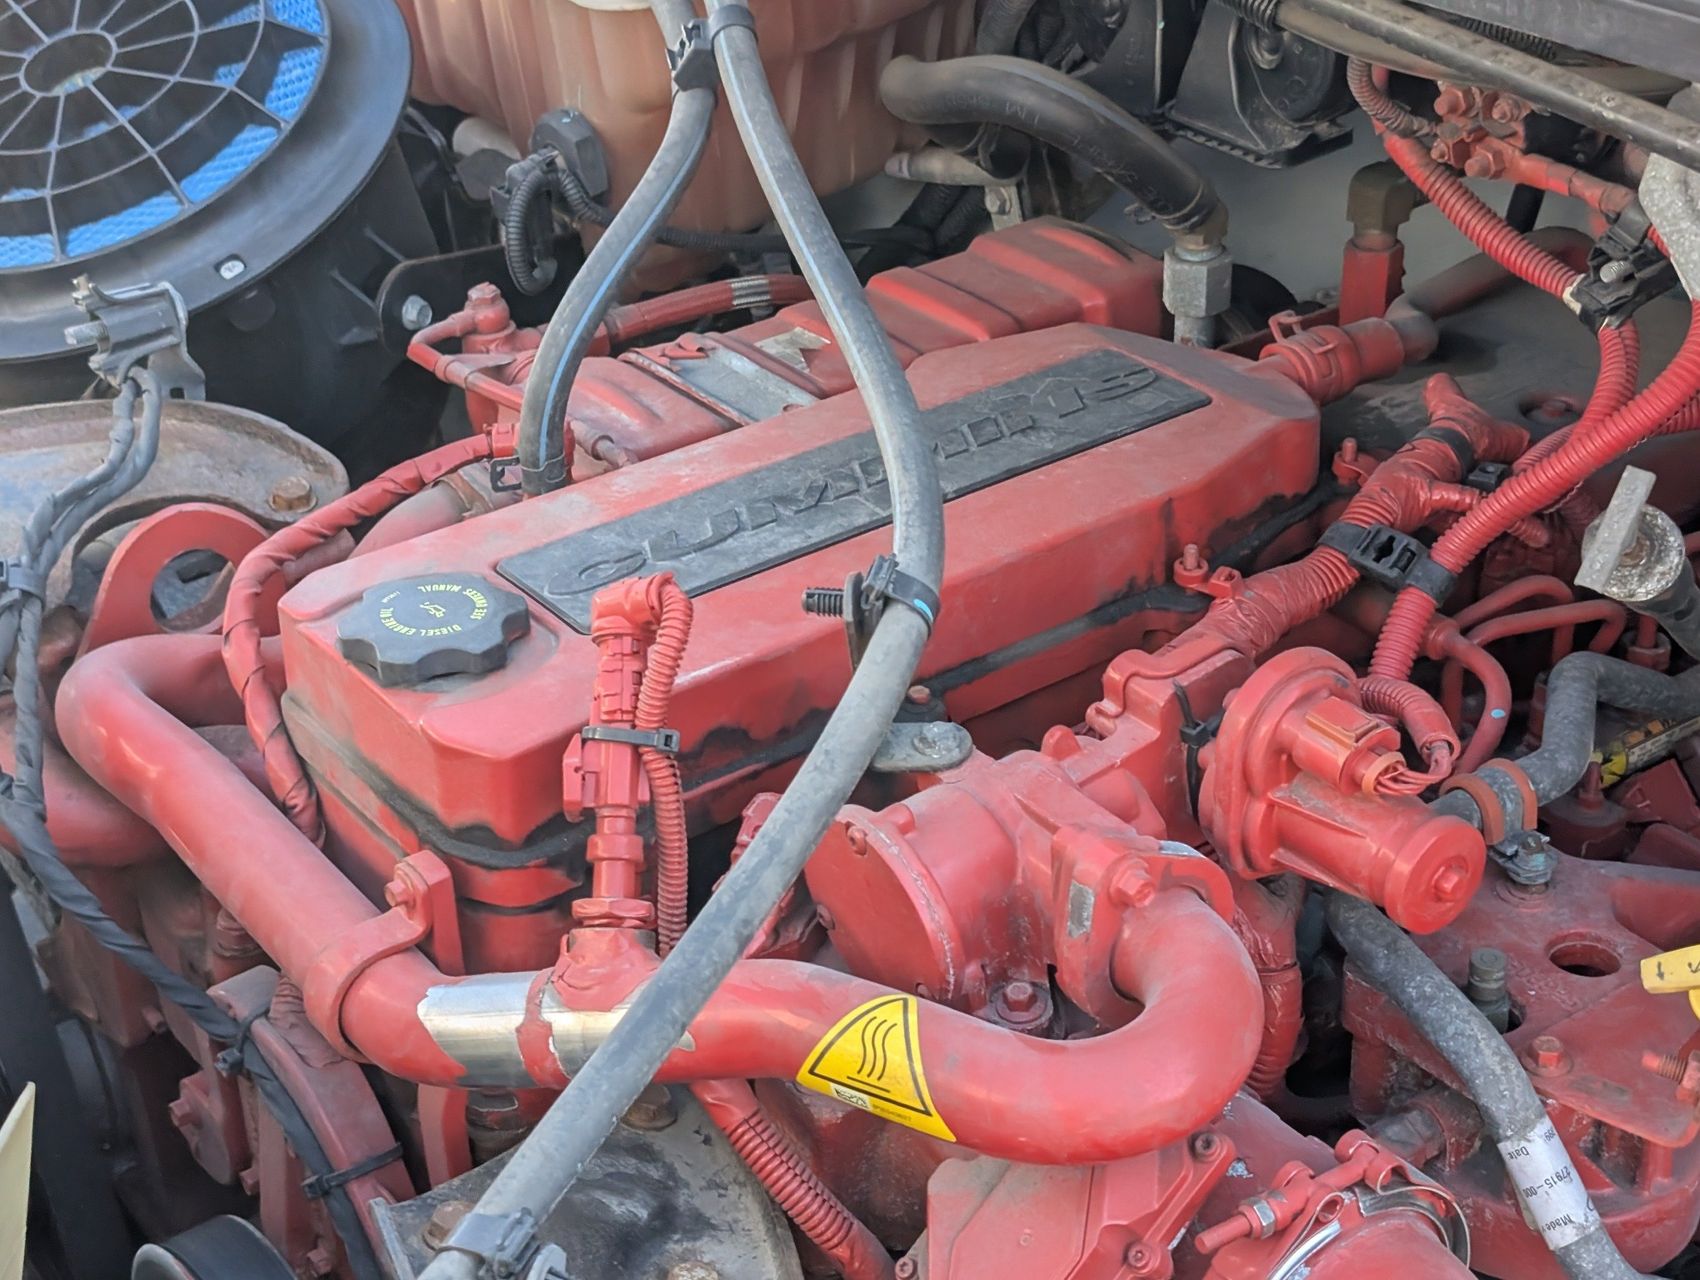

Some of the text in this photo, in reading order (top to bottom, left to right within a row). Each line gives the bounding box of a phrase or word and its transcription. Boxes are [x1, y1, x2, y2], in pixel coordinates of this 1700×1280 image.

[417, 584, 462, 593] MANUAL
[380, 616, 417, 636] ENGINE
[420, 623, 462, 637] DIESEL
[1546, 1213, 1574, 1231] Made
